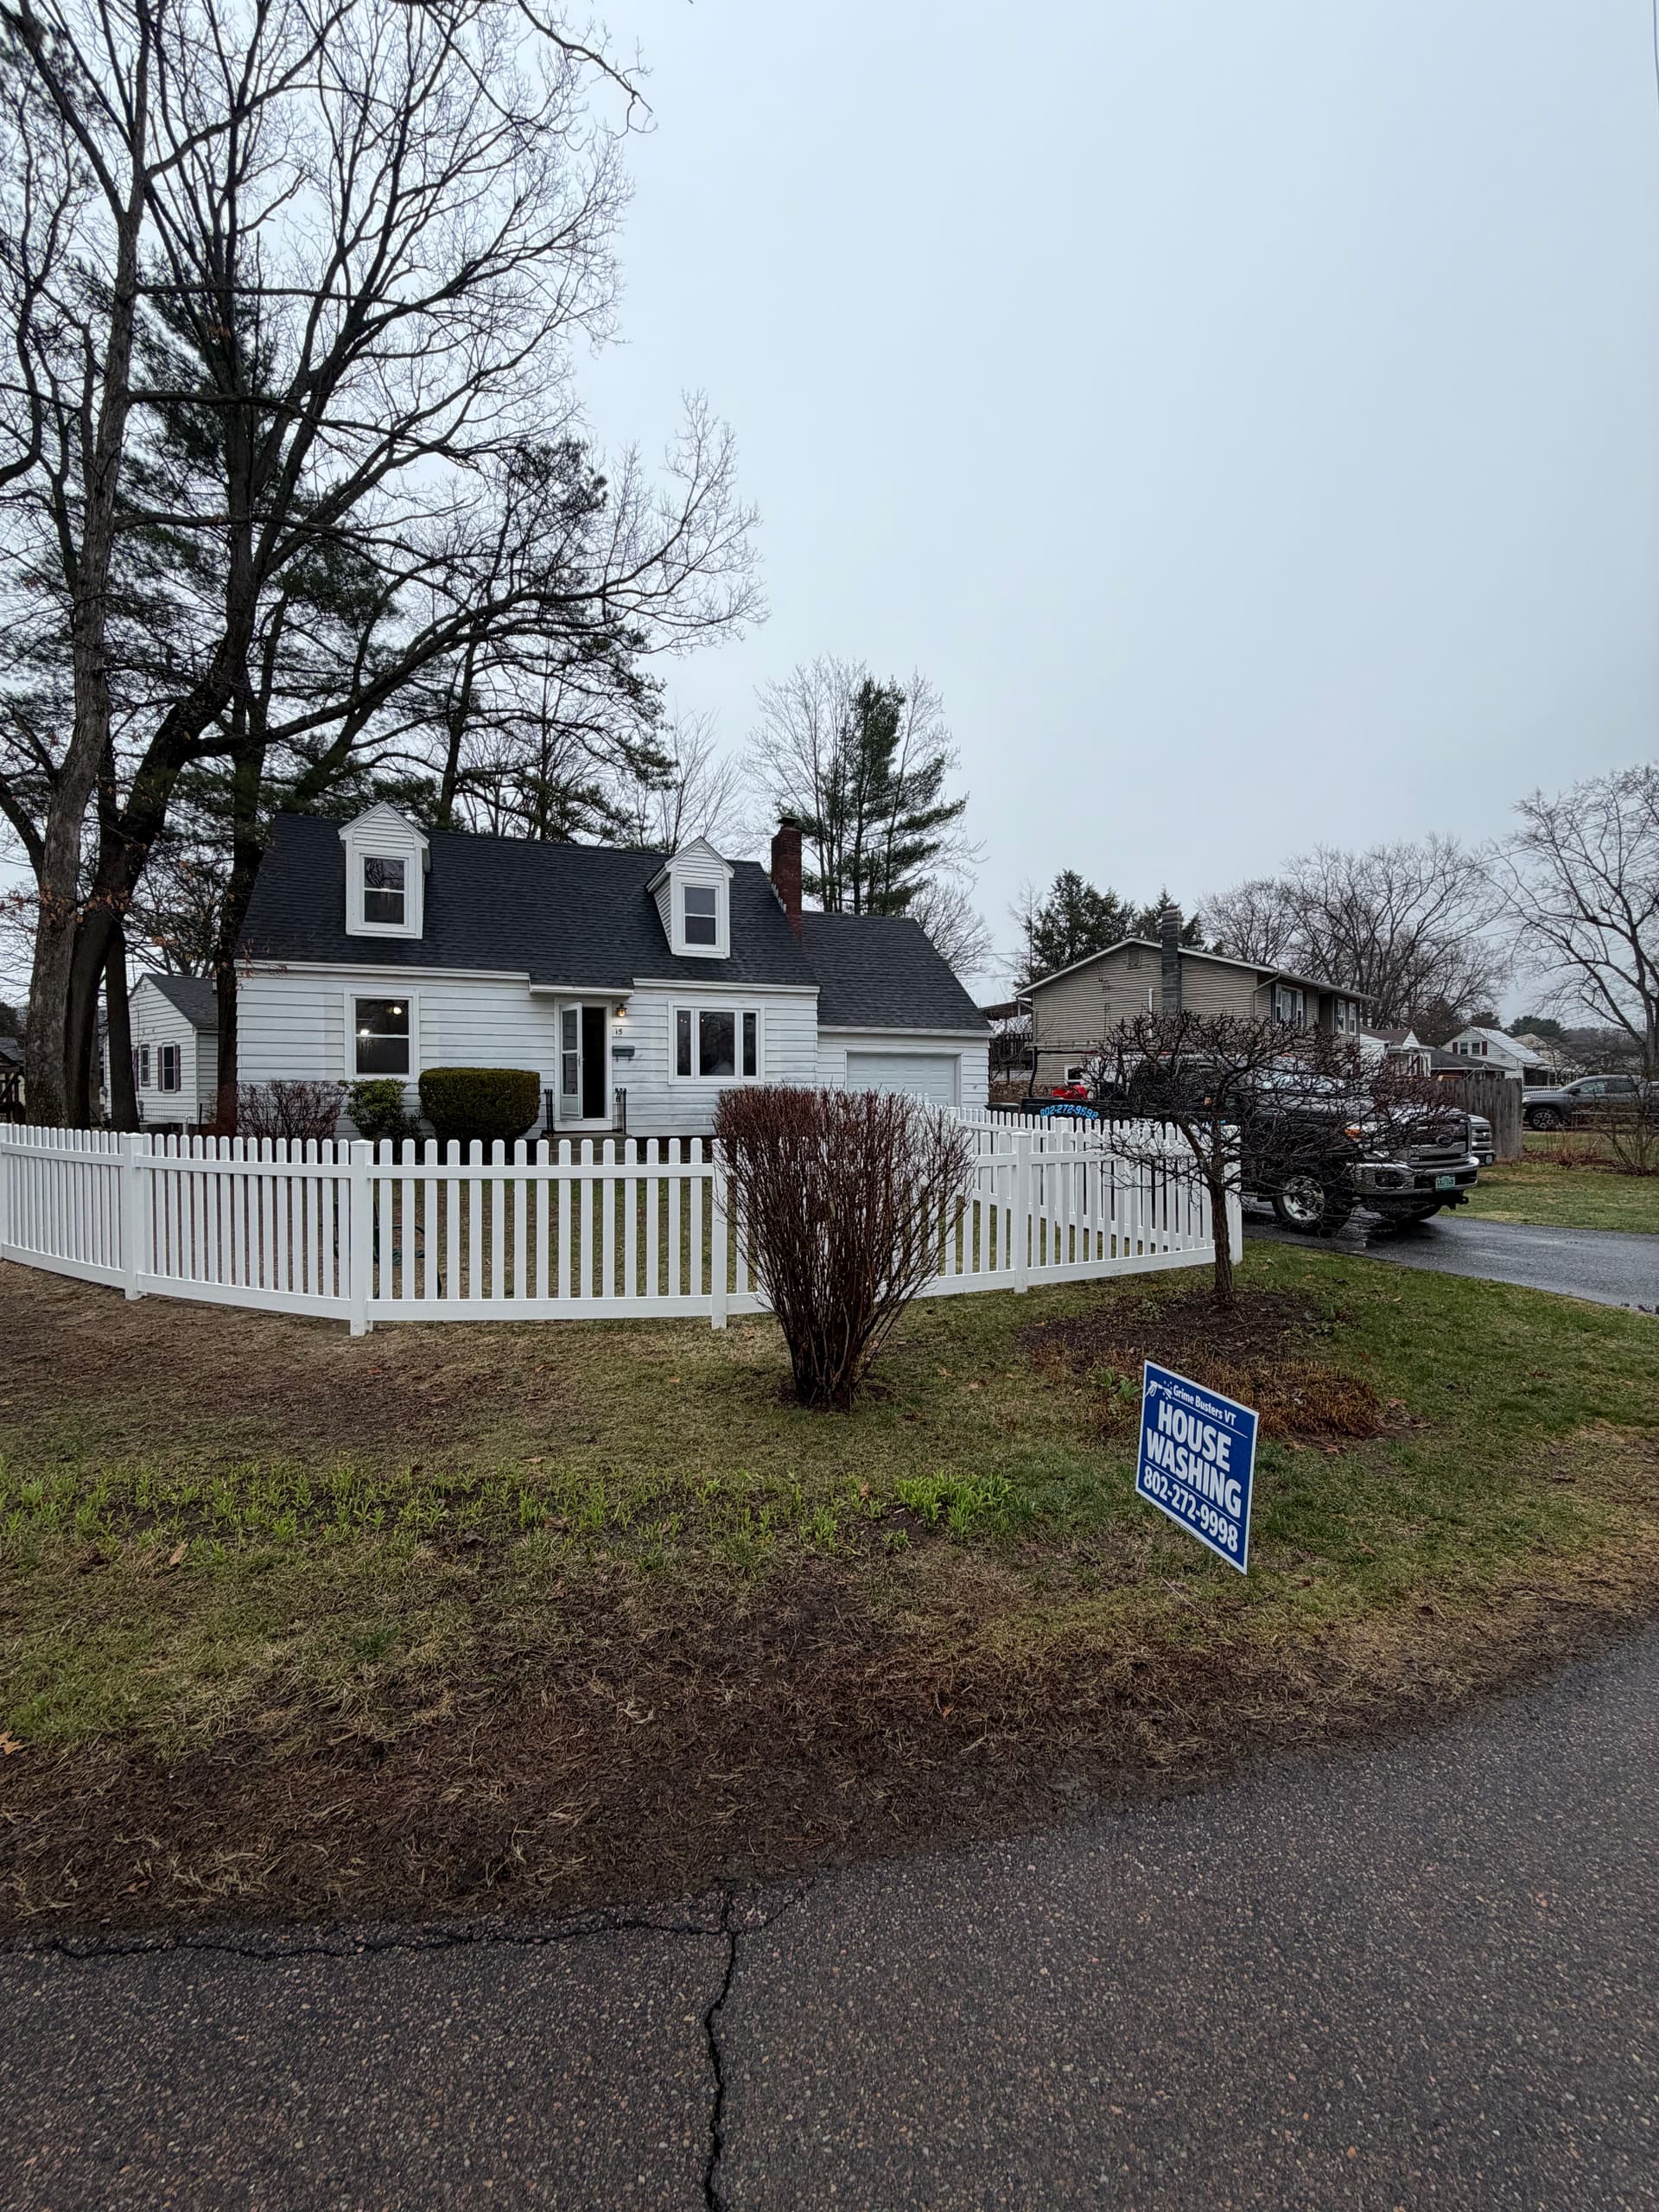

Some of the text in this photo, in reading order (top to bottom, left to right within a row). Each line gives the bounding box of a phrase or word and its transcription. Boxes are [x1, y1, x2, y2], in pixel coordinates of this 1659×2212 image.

[1039, 1104, 1099, 1120] 802-272-9998
[1158, 1399, 1231, 1472] HOUSE
[1173, 1384, 1236, 1426] Grime Busters VT
[1143, 1465, 1238, 1553] 802-272-9998
[1146, 1427, 1242, 1518] WASHING
